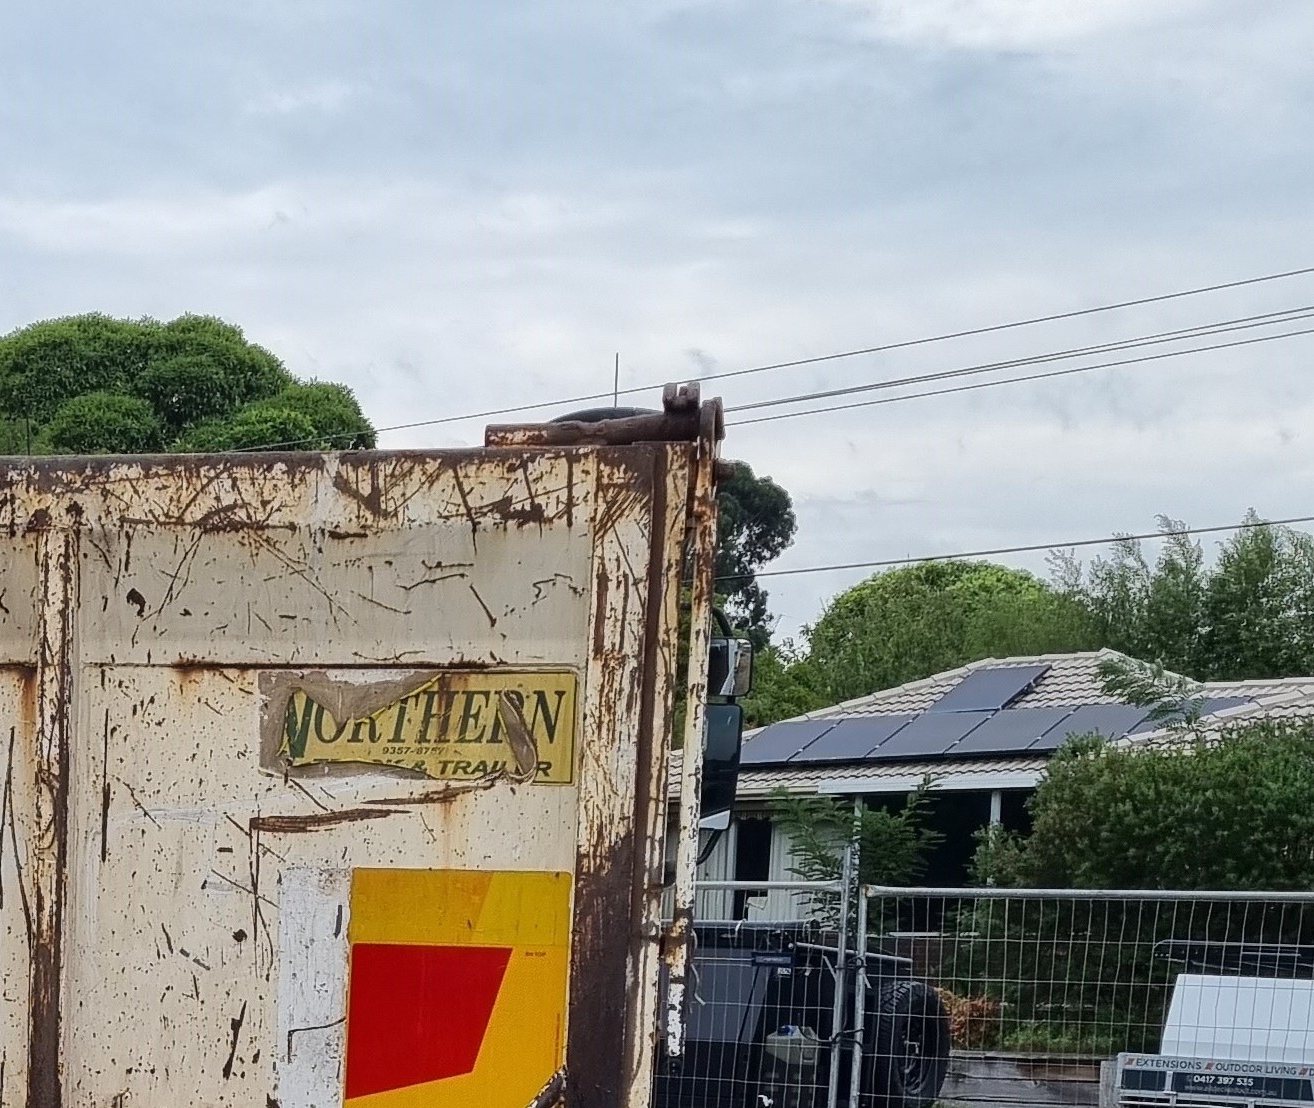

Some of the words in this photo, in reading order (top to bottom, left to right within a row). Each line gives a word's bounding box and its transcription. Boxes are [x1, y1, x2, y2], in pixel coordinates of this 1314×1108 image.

[438, 760, 551, 777] TRAIR
[1136, 1058, 1202, 1070] EXTENSIONS
[1215, 1062, 1262, 1073] OUTDOOR
[1266, 1065, 1297, 1076] LIVING
[1193, 1074, 1216, 1084] 0417
